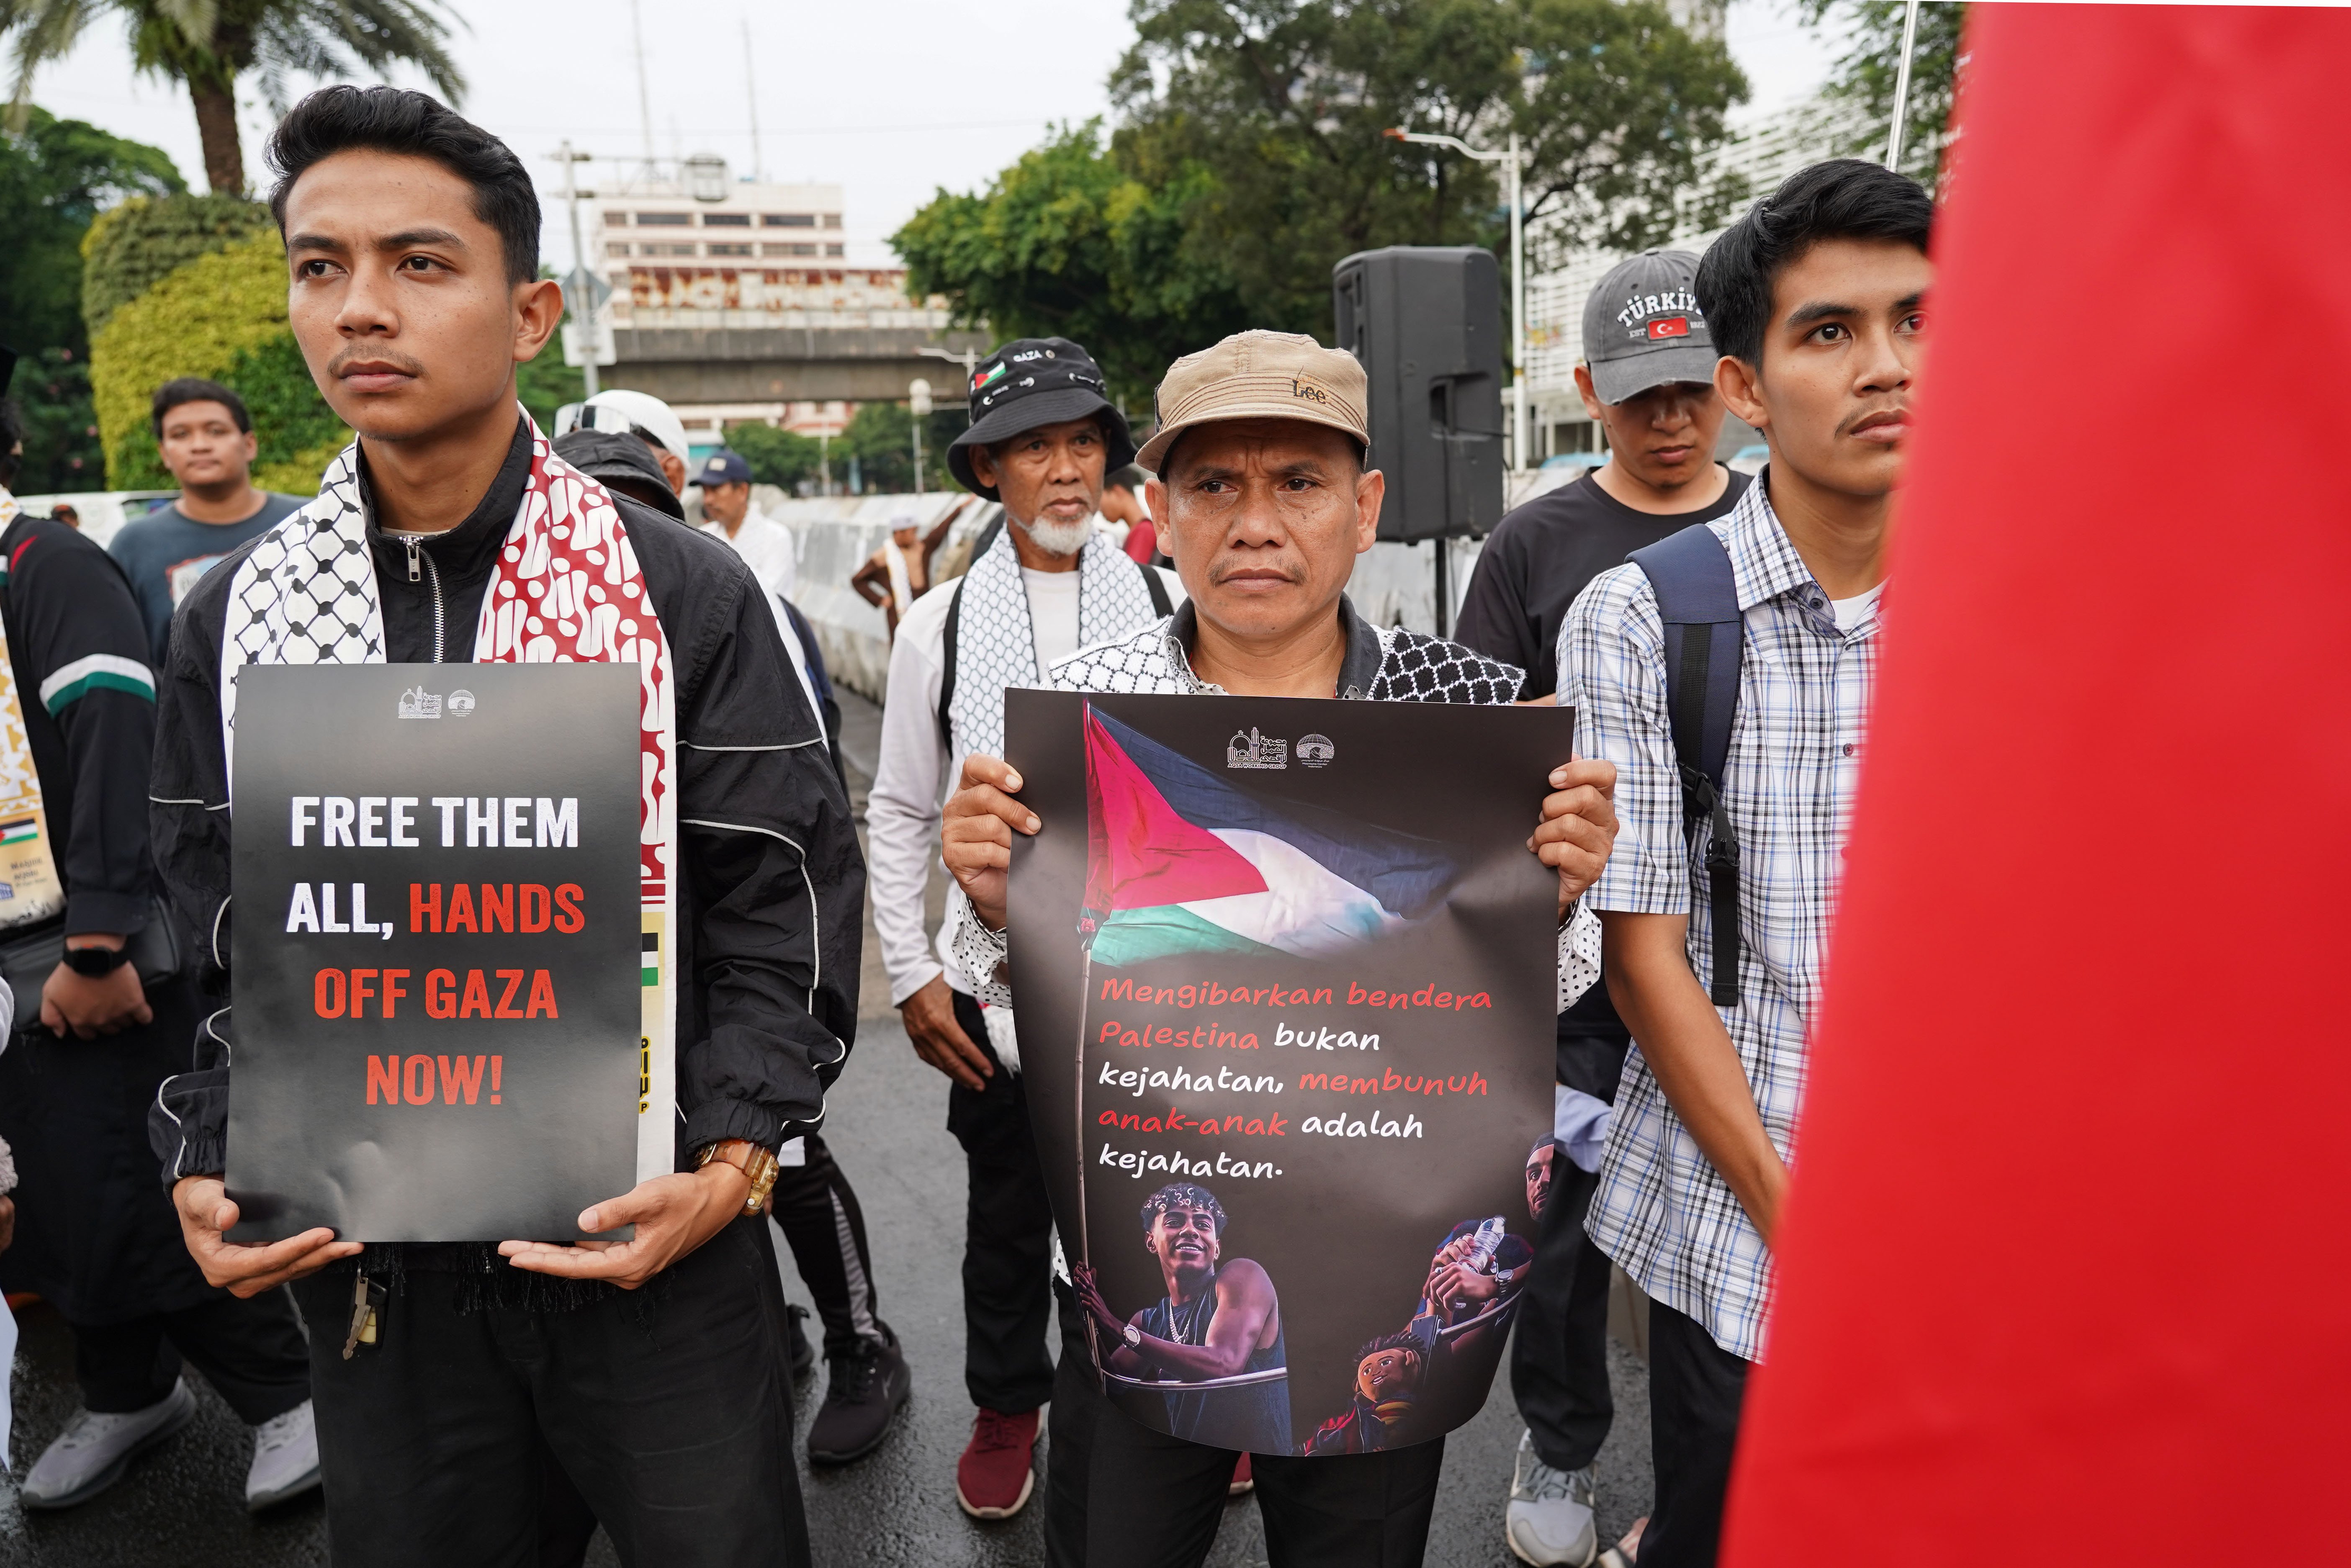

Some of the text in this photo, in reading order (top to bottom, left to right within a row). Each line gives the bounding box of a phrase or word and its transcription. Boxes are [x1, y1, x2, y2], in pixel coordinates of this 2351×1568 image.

[1013, 350, 1043, 362] GAZA
[1292, 378, 1326, 404] Lee
[292, 797, 578, 848] FREE THEM
[286, 883, 585, 940] ALL, HANDS
[314, 968, 558, 1019] OFF GAZA
[1101, 978, 1492, 1010] Mengibarkan bendera
[1099, 1020, 1380, 1051] Palestina bukan
[366, 1054, 502, 1105] NOW!
[1099, 1062, 1487, 1097] kejahatan, membunuh
[1098, 1107, 1422, 1139] anak-anak adalah
[1099, 1143, 1283, 1179] kejahatan.
